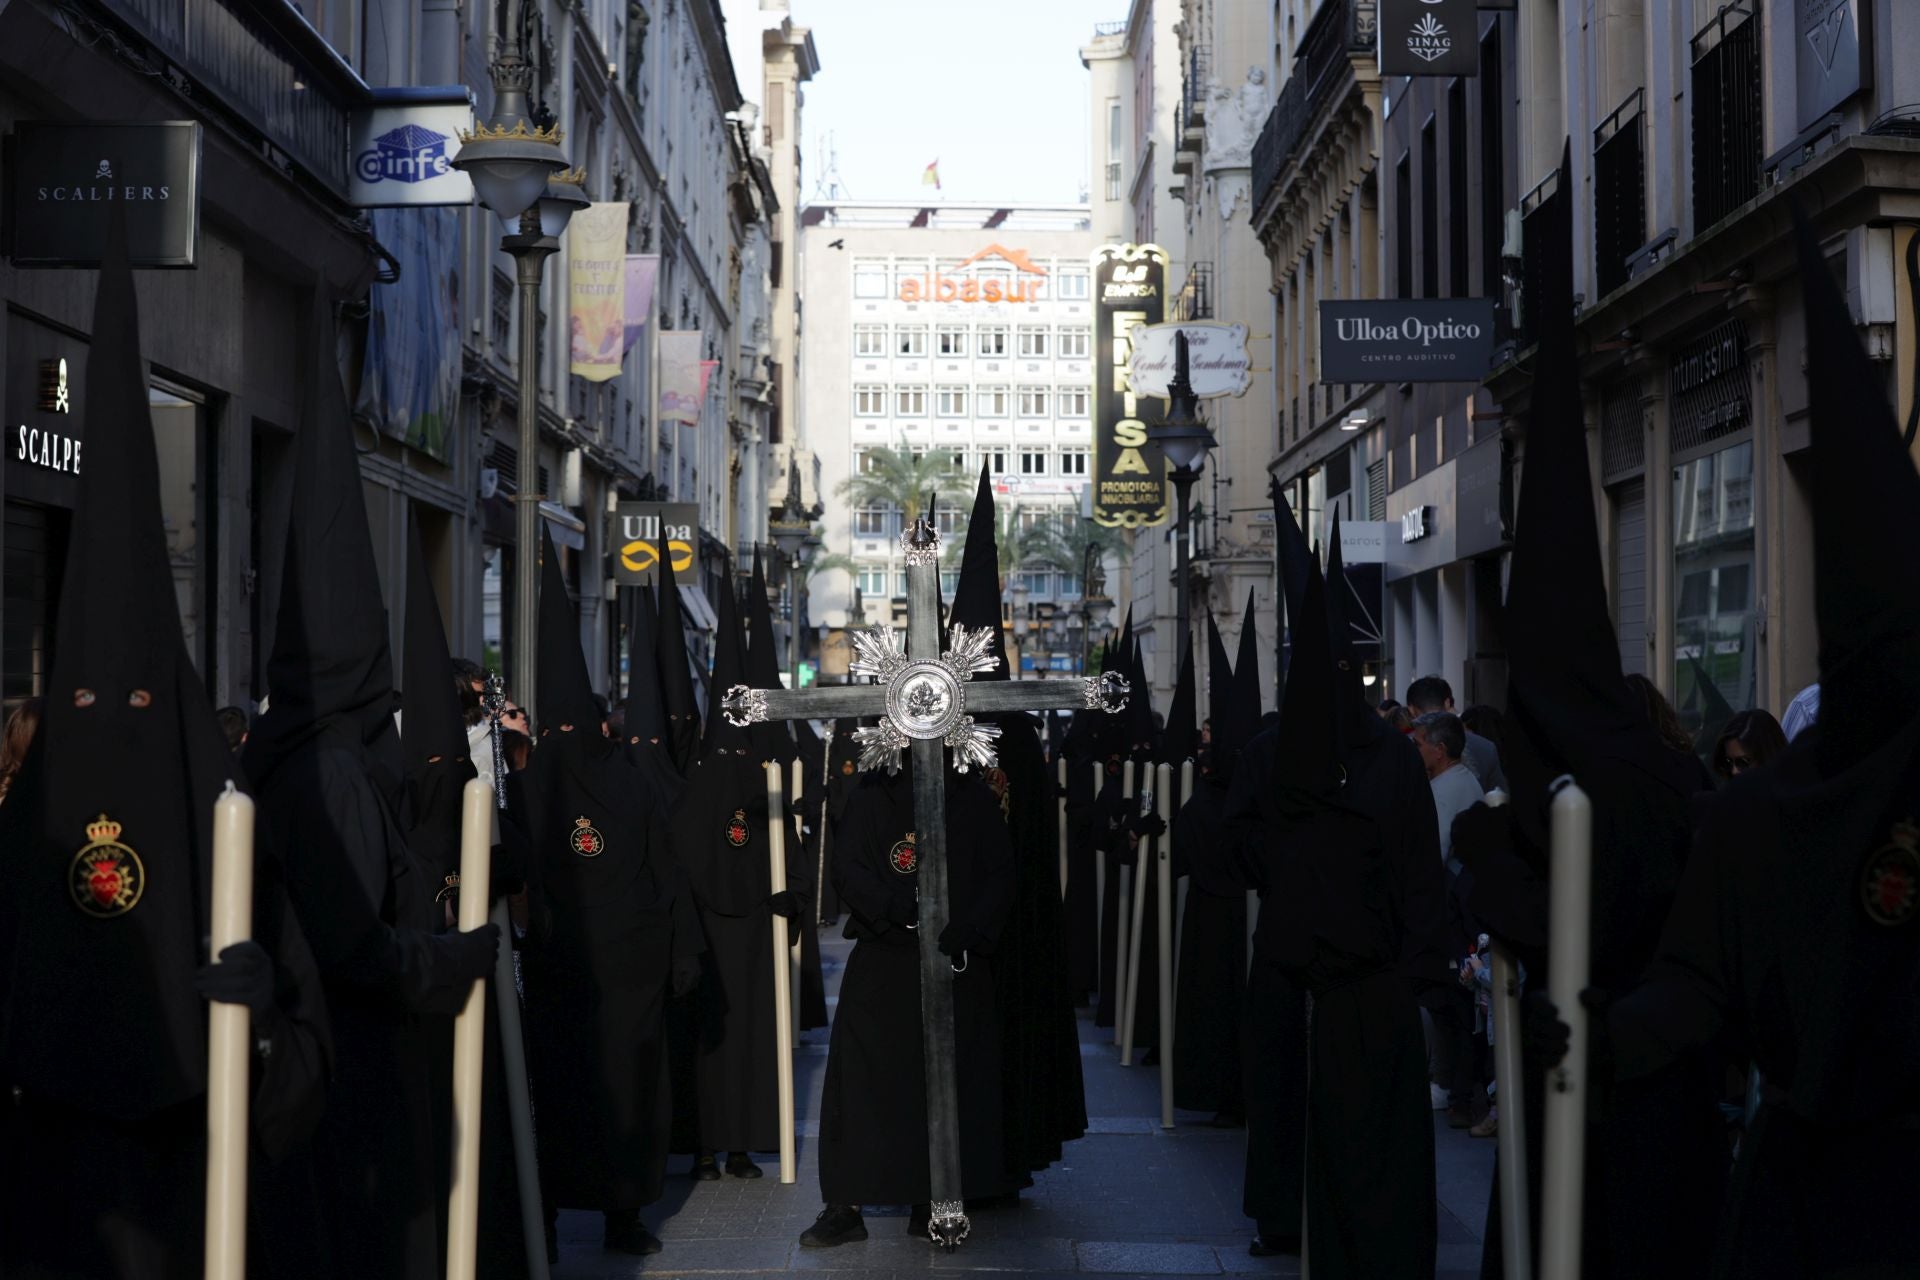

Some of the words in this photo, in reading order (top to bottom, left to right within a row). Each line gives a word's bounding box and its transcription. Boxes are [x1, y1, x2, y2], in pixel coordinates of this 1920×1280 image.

[1407, 37, 1451, 47] SINAG
[899, 272, 1044, 304] albasur
[1335, 318, 1399, 341] Ulloa
[1401, 316, 1481, 346] Optico
[1361, 354, 1402, 362] CENTRO
[1407, 353, 1456, 361] AUDITIVO
[18, 424, 82, 475] SCALPE
[1101, 481, 1160, 493] PROMOTORA
[1101, 493, 1160, 505] INMOBILIARIA
[621, 515, 692, 541] Ulloa
[1343, 538, 1382, 546] ARFOIS
